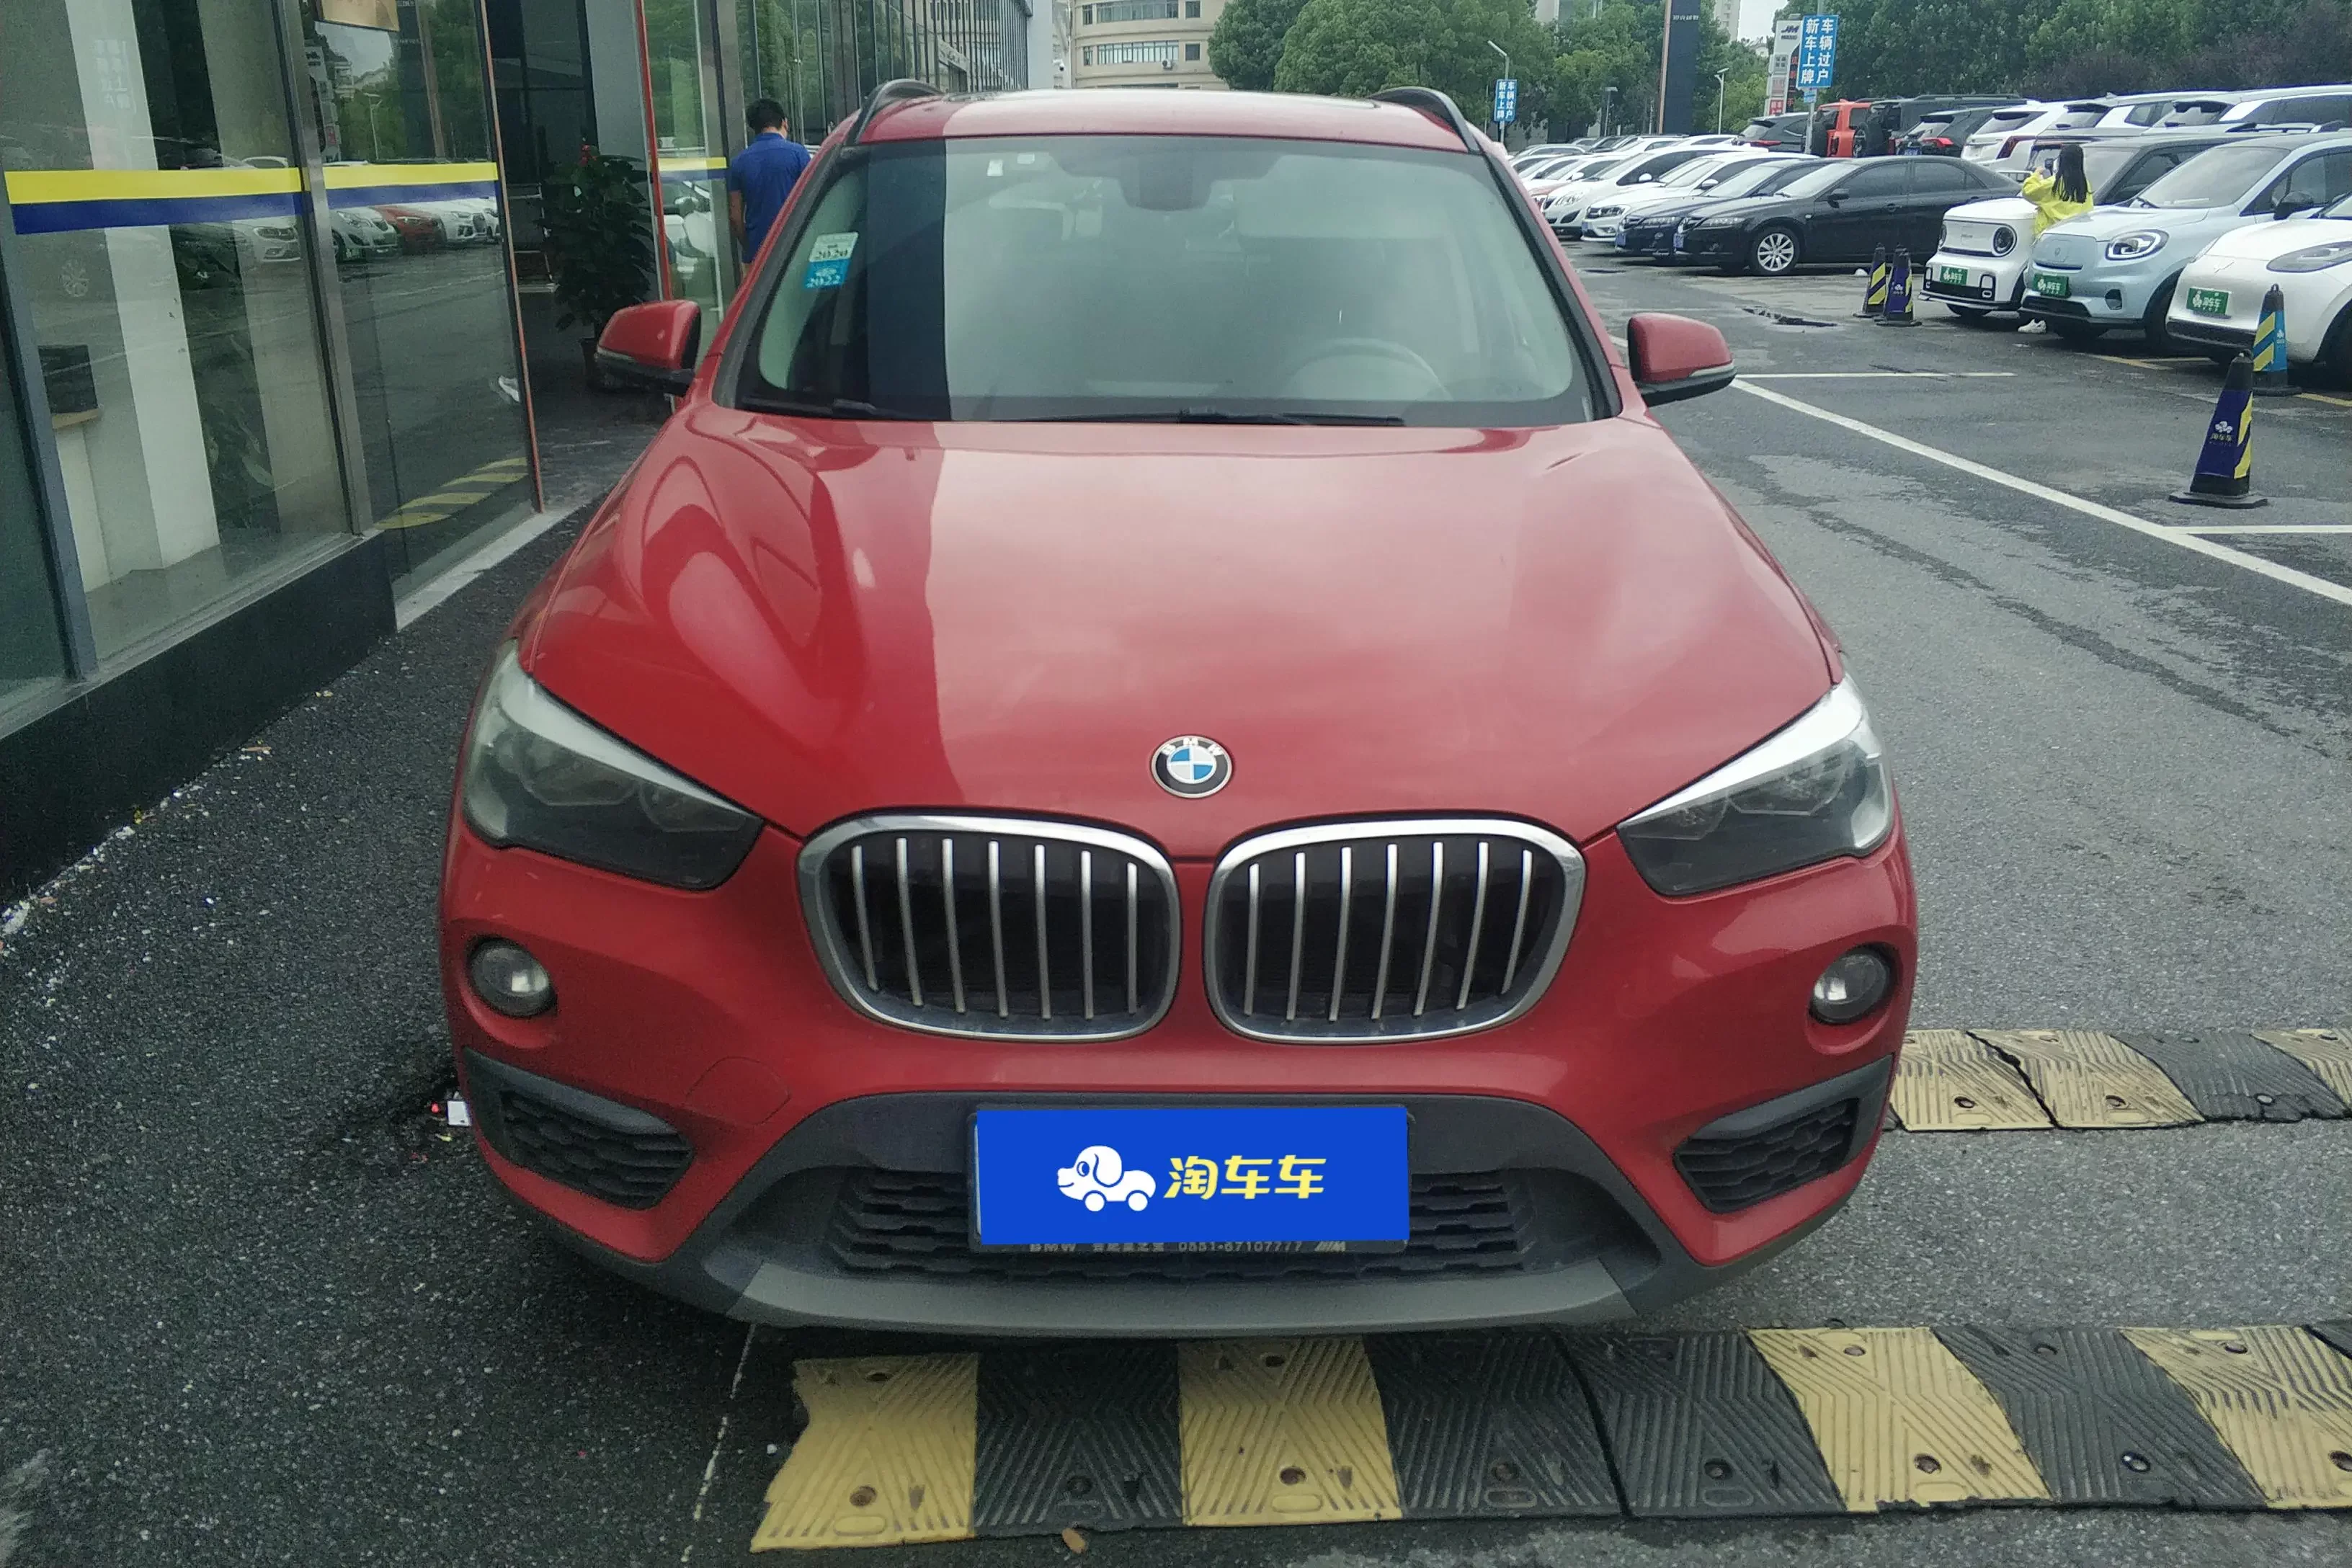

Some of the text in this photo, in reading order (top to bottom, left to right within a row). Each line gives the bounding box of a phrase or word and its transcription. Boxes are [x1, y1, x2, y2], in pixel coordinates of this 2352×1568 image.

[1800, 17, 1820, 84] 新车上牌
[1815, 18, 1835, 84] 车辆过户
[1160, 736, 1224, 757] BMW
